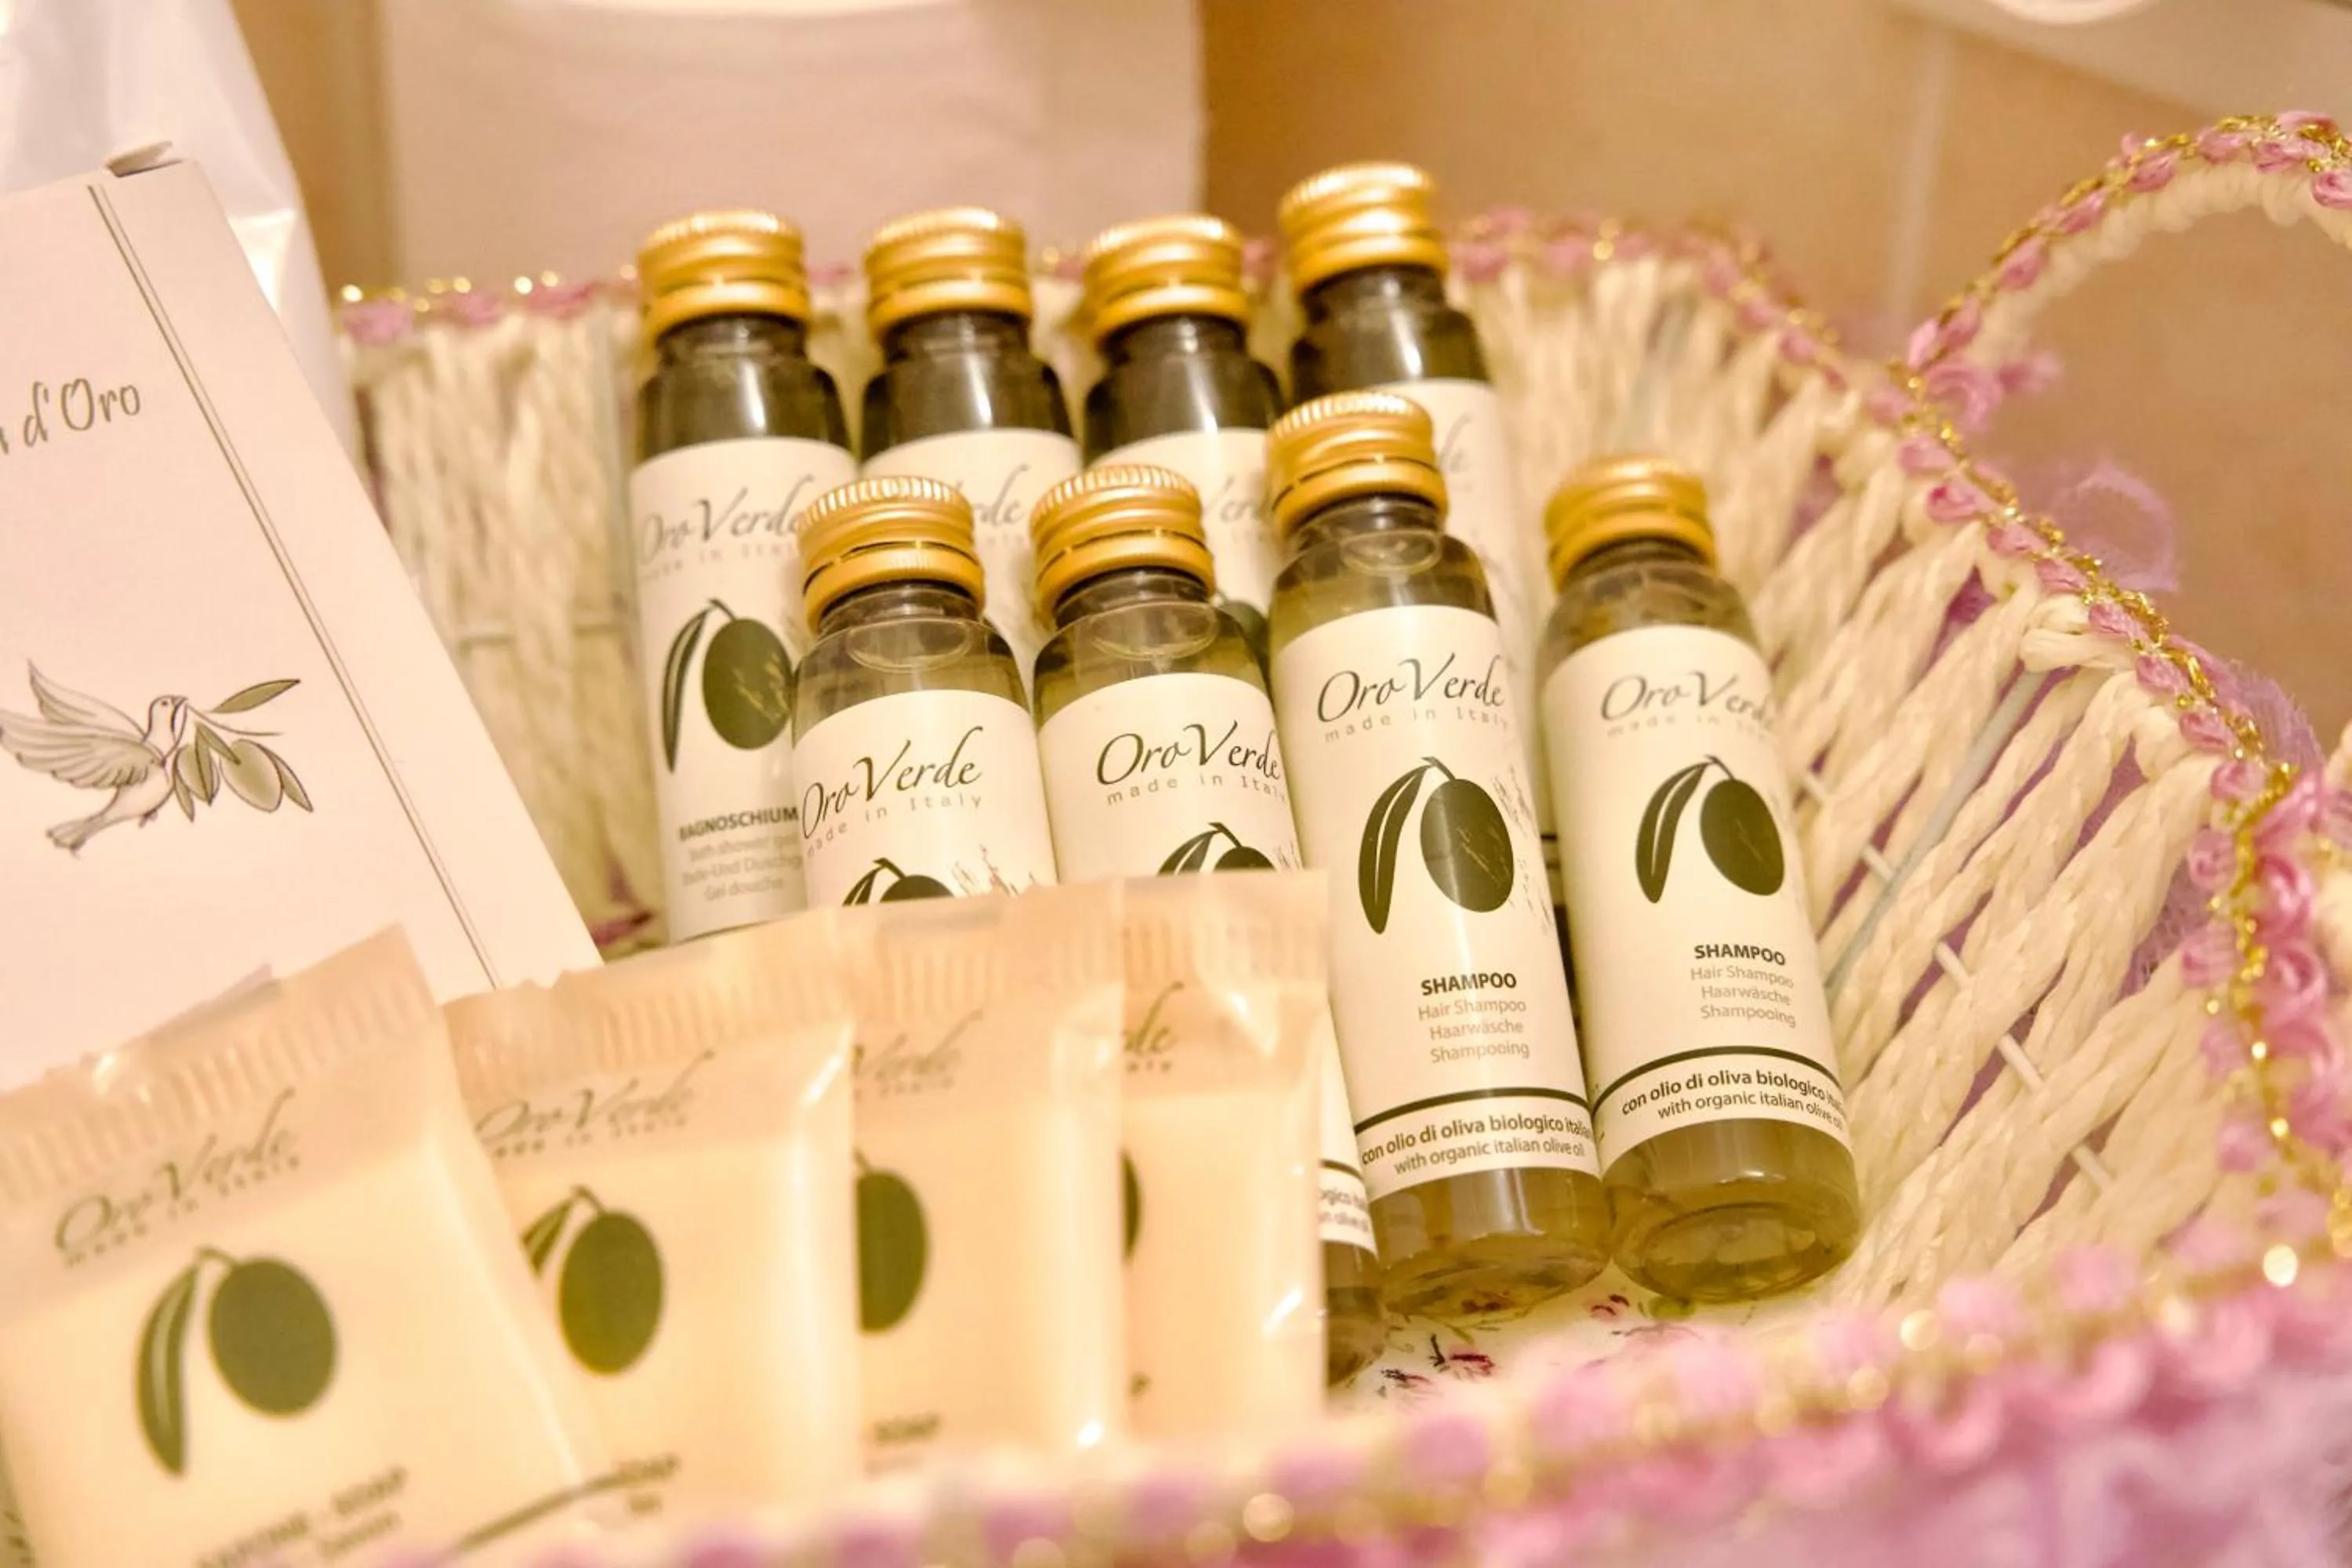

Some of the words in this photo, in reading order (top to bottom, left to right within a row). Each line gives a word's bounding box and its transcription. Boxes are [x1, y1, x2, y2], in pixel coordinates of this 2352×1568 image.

[24, 377, 141, 448] d'Oro
[1325, 714, 1392, 743] made
[1413, 707, 1436, 720] in
[1106, 779, 1178, 806] made
[1200, 774, 1223, 787] in
[864, 806, 887, 822] in
[909, 792, 982, 811] Italy
[678, 806, 799, 842] BAGNOSCHIUM
[1693, 943, 1785, 966] SHAMPOO
[1421, 972, 1517, 996] SHAMPOO
[1690, 966, 1723, 981] Hair
[1726, 965, 1794, 989] Shampoo
[1418, 1001, 1450, 1022] Hair
[1454, 999, 1526, 1015] Shampoo
[1700, 1004, 1796, 1029] Shampooing
[1430, 1040, 1530, 1064] Shampooing
[1622, 1093, 1646, 1116] con
[1650, 1081, 1682, 1101] olio
[1686, 1073, 1704, 1090] di
[1708, 1069, 1752, 1086] oliva
[1756, 1069, 1826, 1101] biologico
[1657, 1098, 1692, 1119] with
[1695, 1091, 1756, 1110] organic
[1759, 1091, 1804, 1111] italian
[1361, 1145, 1385, 1166] con
[1386, 1131, 1417, 1154] olio
[1420, 1123, 1438, 1143] di
[1441, 1120, 1486, 1139] oliva
[1489, 1113, 1564, 1134] biologico
[1394, 1152, 1428, 1174] with
[1429, 1141, 1491, 1166] organic
[1494, 1137, 1541, 1154] italian
[1542, 1137, 1573, 1156] olive
